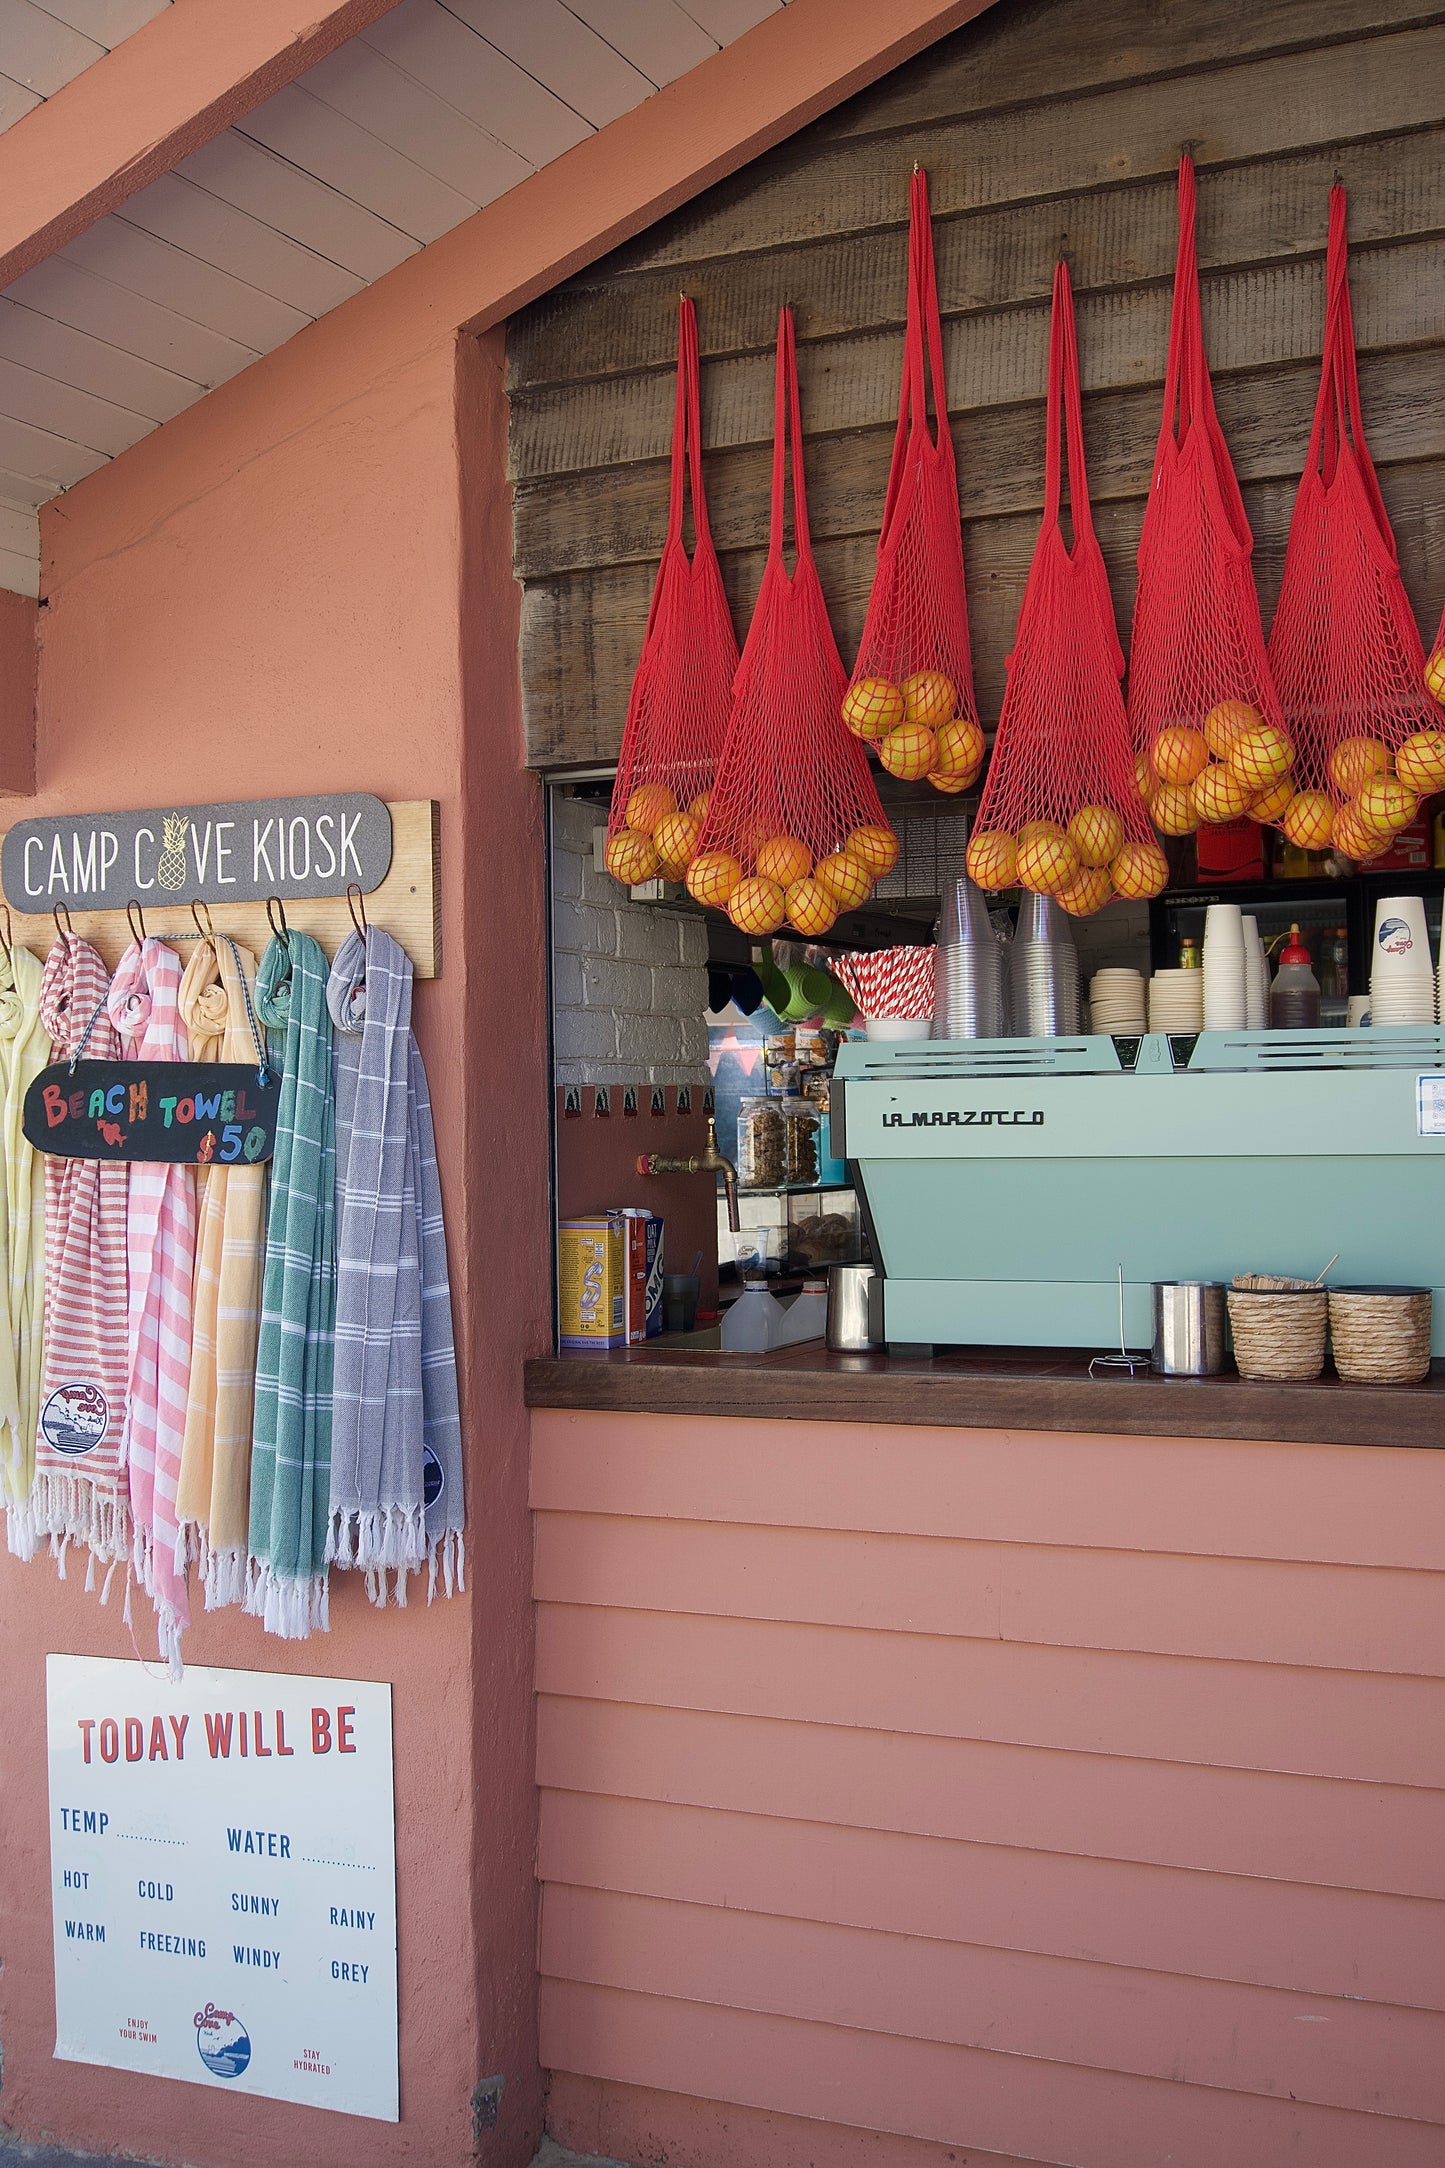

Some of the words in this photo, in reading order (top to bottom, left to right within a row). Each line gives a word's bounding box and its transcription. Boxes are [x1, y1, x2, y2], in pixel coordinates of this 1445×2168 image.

[23, 831, 119, 896] CAMP
[252, 811, 364, 883] KIOSK
[41, 1079, 149, 1128] BEACH
[159, 1089, 256, 1128] TOWEL
[882, 1112, 903, 1127] LA
[911, 1110, 1045, 1127] MARZOCCO
[196, 1124, 266, 1163] $50
[77, 1713, 190, 1764] TODAY
[203, 1709, 294, 1759] WILL
[310, 1705, 357, 1755] BE
[60, 1807, 110, 1836] TEMP
[226, 1827, 292, 1859] WATER
[63, 1869, 90, 1890] HOT
[138, 1880, 174, 1902] COLD
[231, 1892, 280, 1917] SUNNY
[330, 1906, 376, 1931] RAINY
[65, 1919, 106, 1943] WARM
[139, 1931, 207, 1958] FREEZING
[232, 1944, 281, 1970] WINDY
[330, 1960, 370, 1984] GREY
[119, 2028, 136, 2041] YOUR
[138, 2030, 158, 2043] SWIM
[127, 2017, 149, 2030] ENJOY
[293, 2059, 332, 2075] HYDRATED
[303, 2048, 321, 2060] STAY
